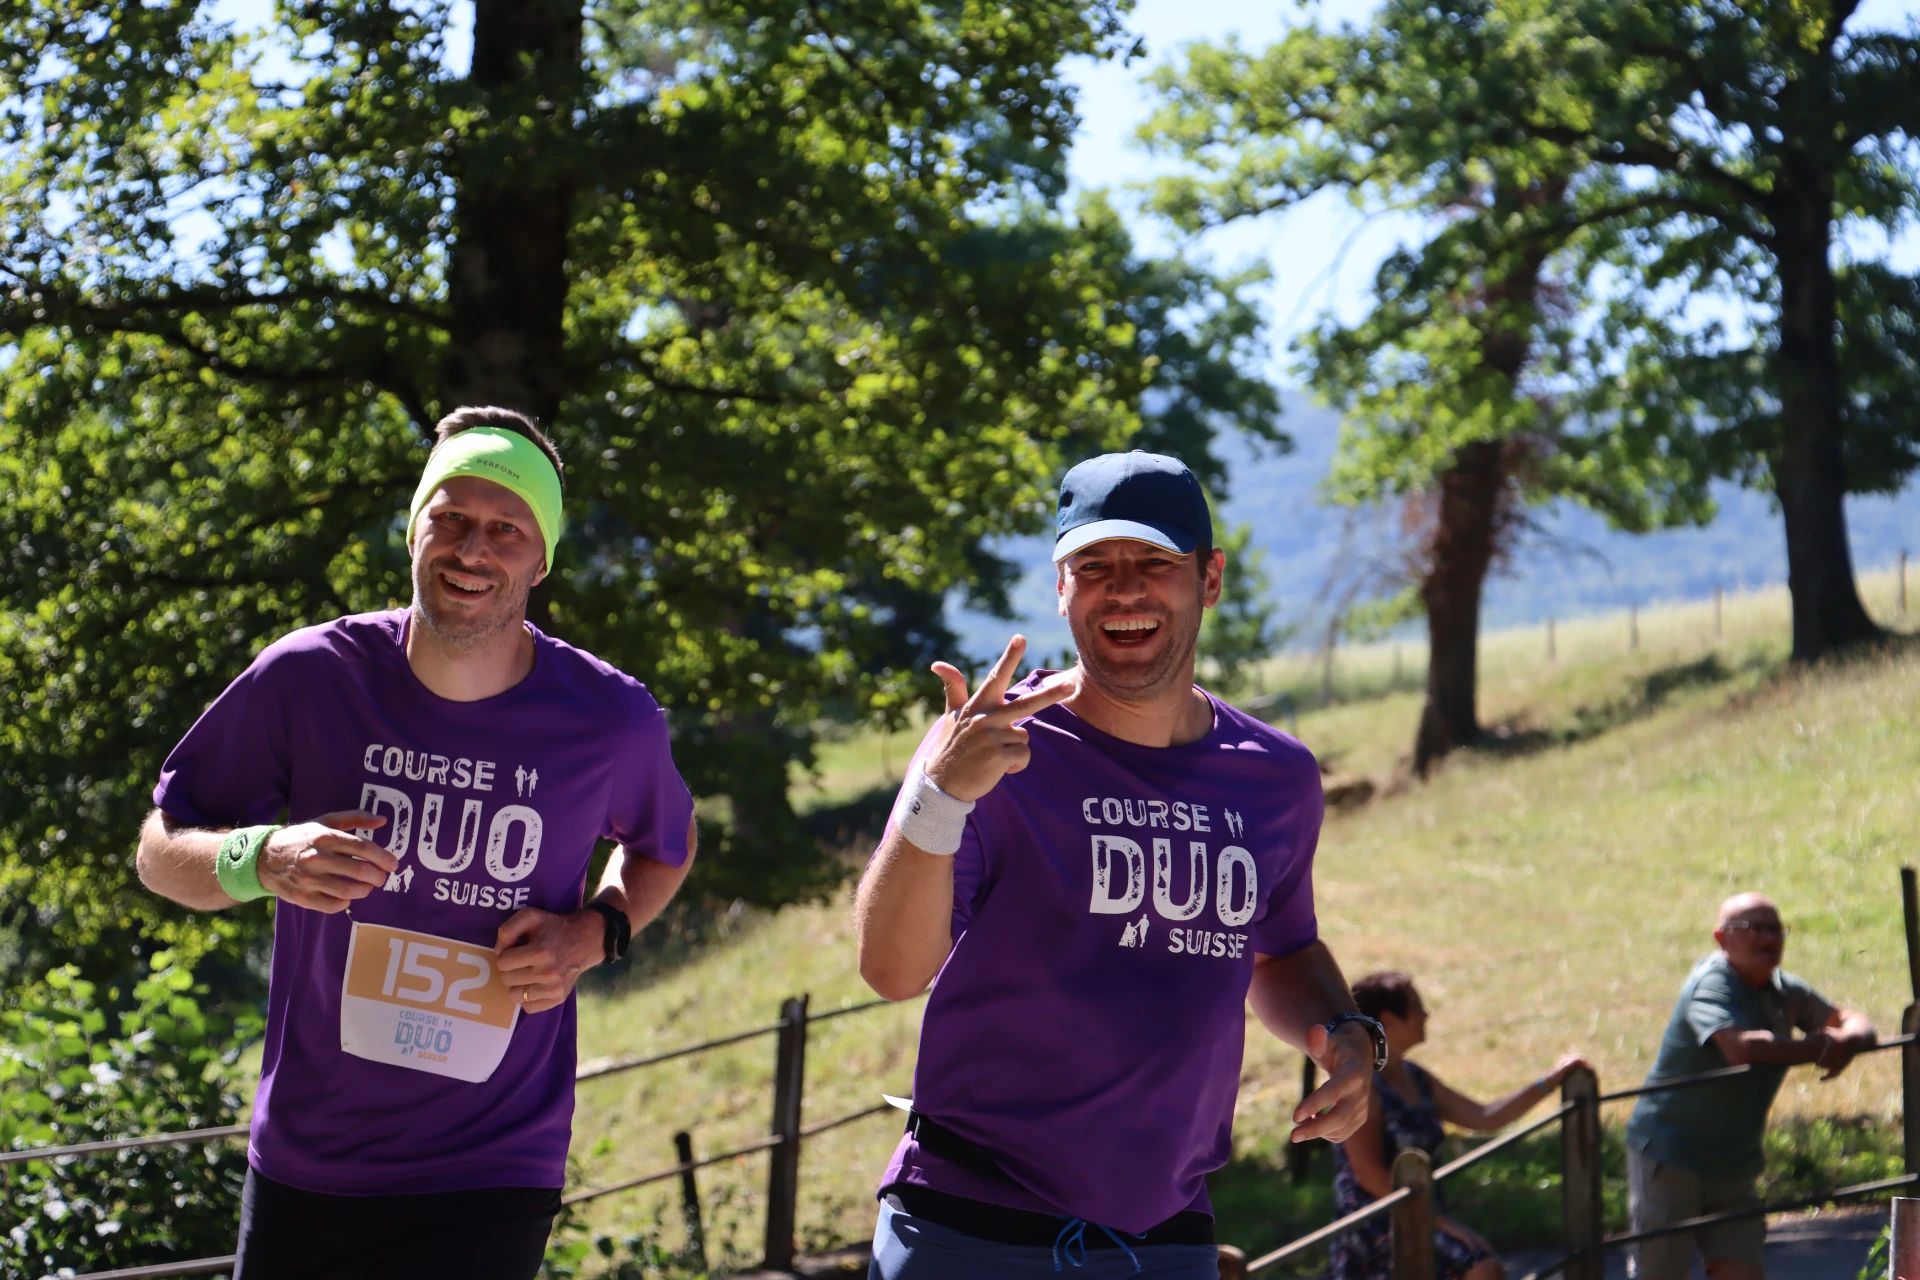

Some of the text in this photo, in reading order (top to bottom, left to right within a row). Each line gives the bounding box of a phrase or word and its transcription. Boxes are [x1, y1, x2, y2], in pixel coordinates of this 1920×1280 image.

[476, 459, 520, 480] PERFORM
[363, 743, 496, 791] COURSE
[1082, 797, 1211, 832] COURSE
[352, 782, 543, 883] DUO
[433, 878, 531, 910] SUISSE
[1089, 834, 1258, 927] DUO
[1168, 927, 1248, 959] SUISSE
[381, 937, 491, 1015] 152
[399, 1010, 440, 1026] COURSE
[394, 1021, 452, 1054] DUO
[417, 1050, 449, 1063] SUISSE
